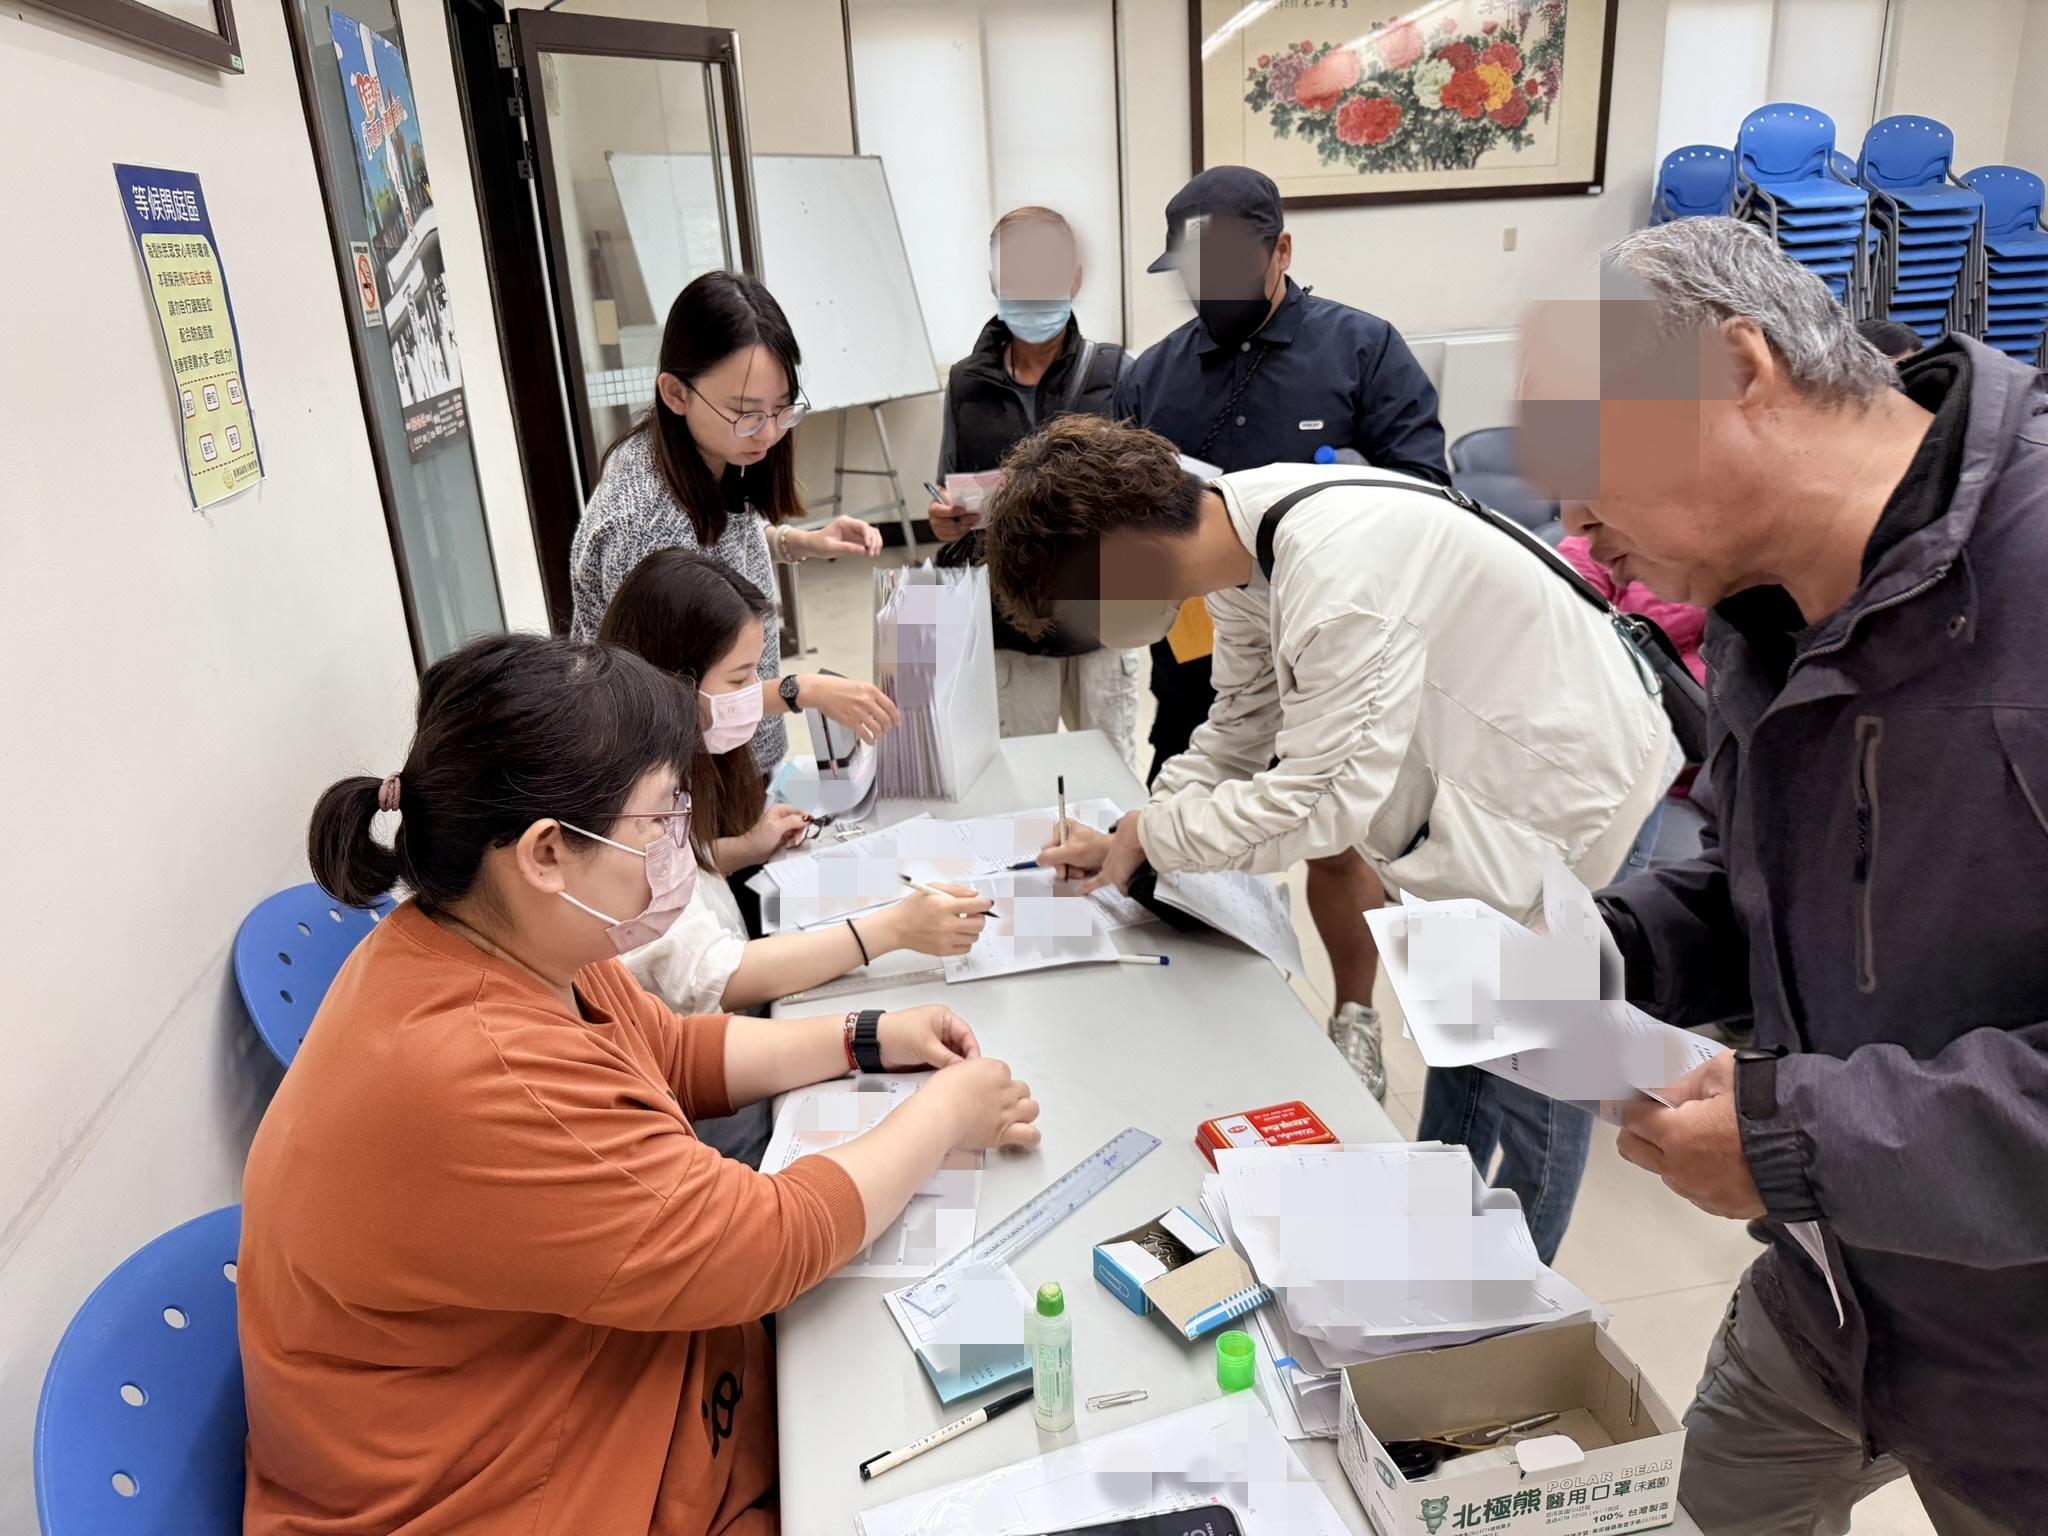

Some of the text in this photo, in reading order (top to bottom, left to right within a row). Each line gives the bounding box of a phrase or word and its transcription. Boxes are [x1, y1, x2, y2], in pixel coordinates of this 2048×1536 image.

[132, 185, 200, 222] 等候開庭區
[1546, 1476, 1669, 1510] 醫用口罩 (未滅菌)
[1547, 1459, 1673, 1493] POLAR BEAR
[1452, 1487, 1541, 1529] 北極熊
[1593, 1502, 1669, 1524] 100% 台灣製造
